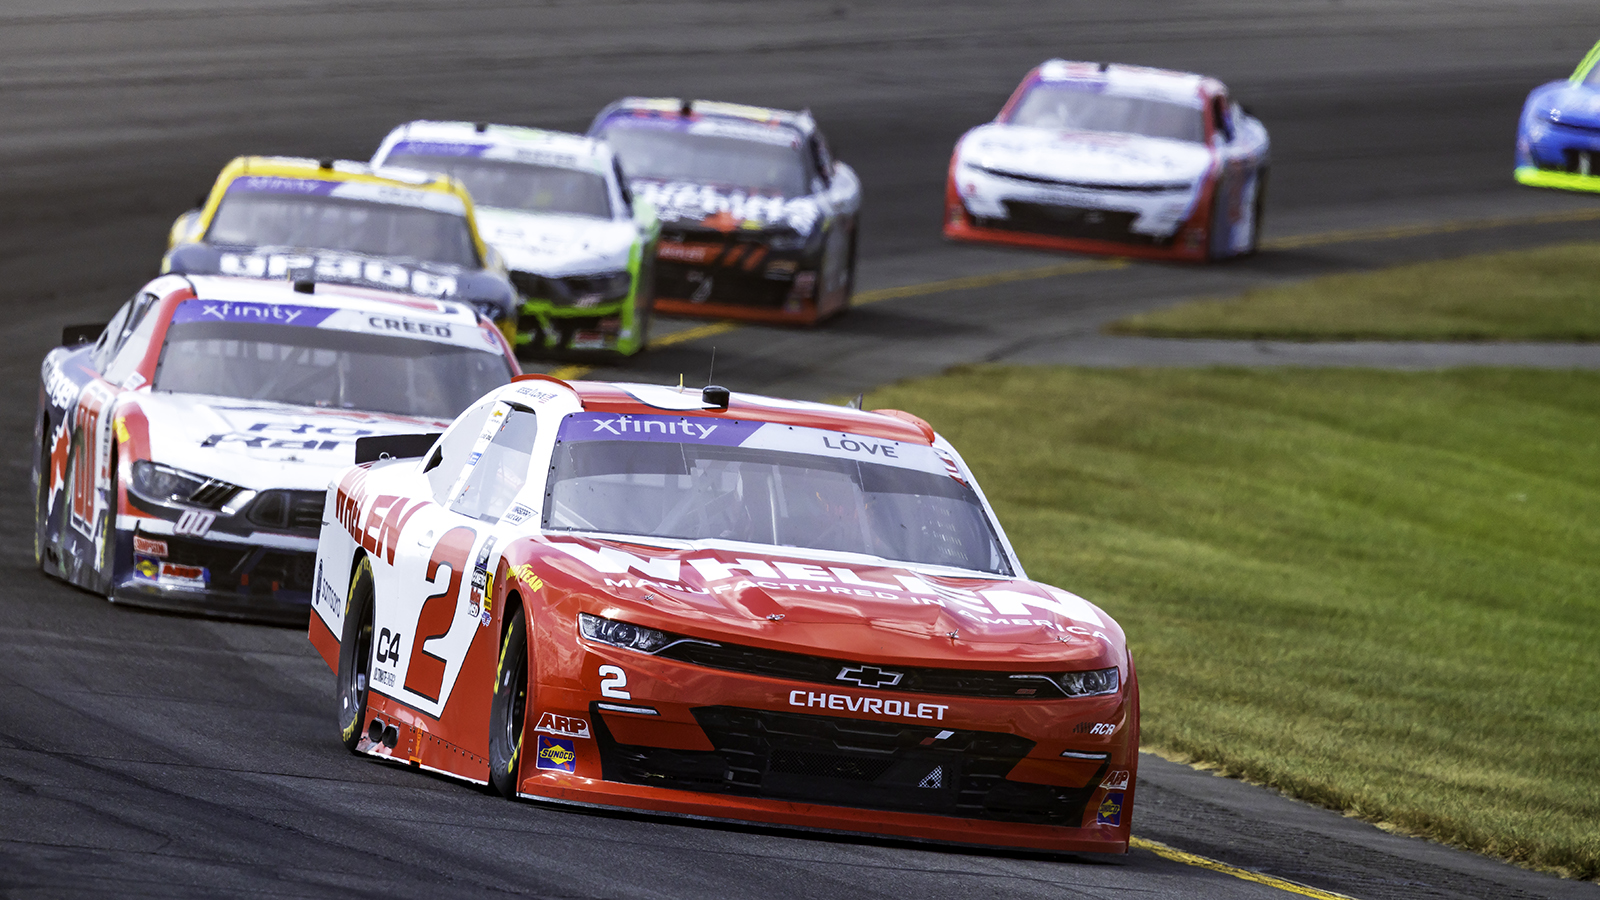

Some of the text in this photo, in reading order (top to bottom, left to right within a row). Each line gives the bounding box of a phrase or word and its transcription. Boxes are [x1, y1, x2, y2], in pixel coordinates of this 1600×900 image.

[201, 301, 452, 338] xfinity CREED
[592, 415, 899, 459] xfinity LOVE
[173, 508, 217, 537] 00
[545, 538, 1105, 629] WHELEN
[403, 525, 478, 704] 2
[604, 577, 1113, 645] MANUFACTURED IN AMERICA
[377, 627, 401, 668] C4
[598, 664, 631, 700] 2
[537, 713, 587, 734] ARP
[789, 690, 949, 721] CHEVROLET
[1090, 723, 1115, 735] RCR
[541, 749, 575, 761] SUNOCO
